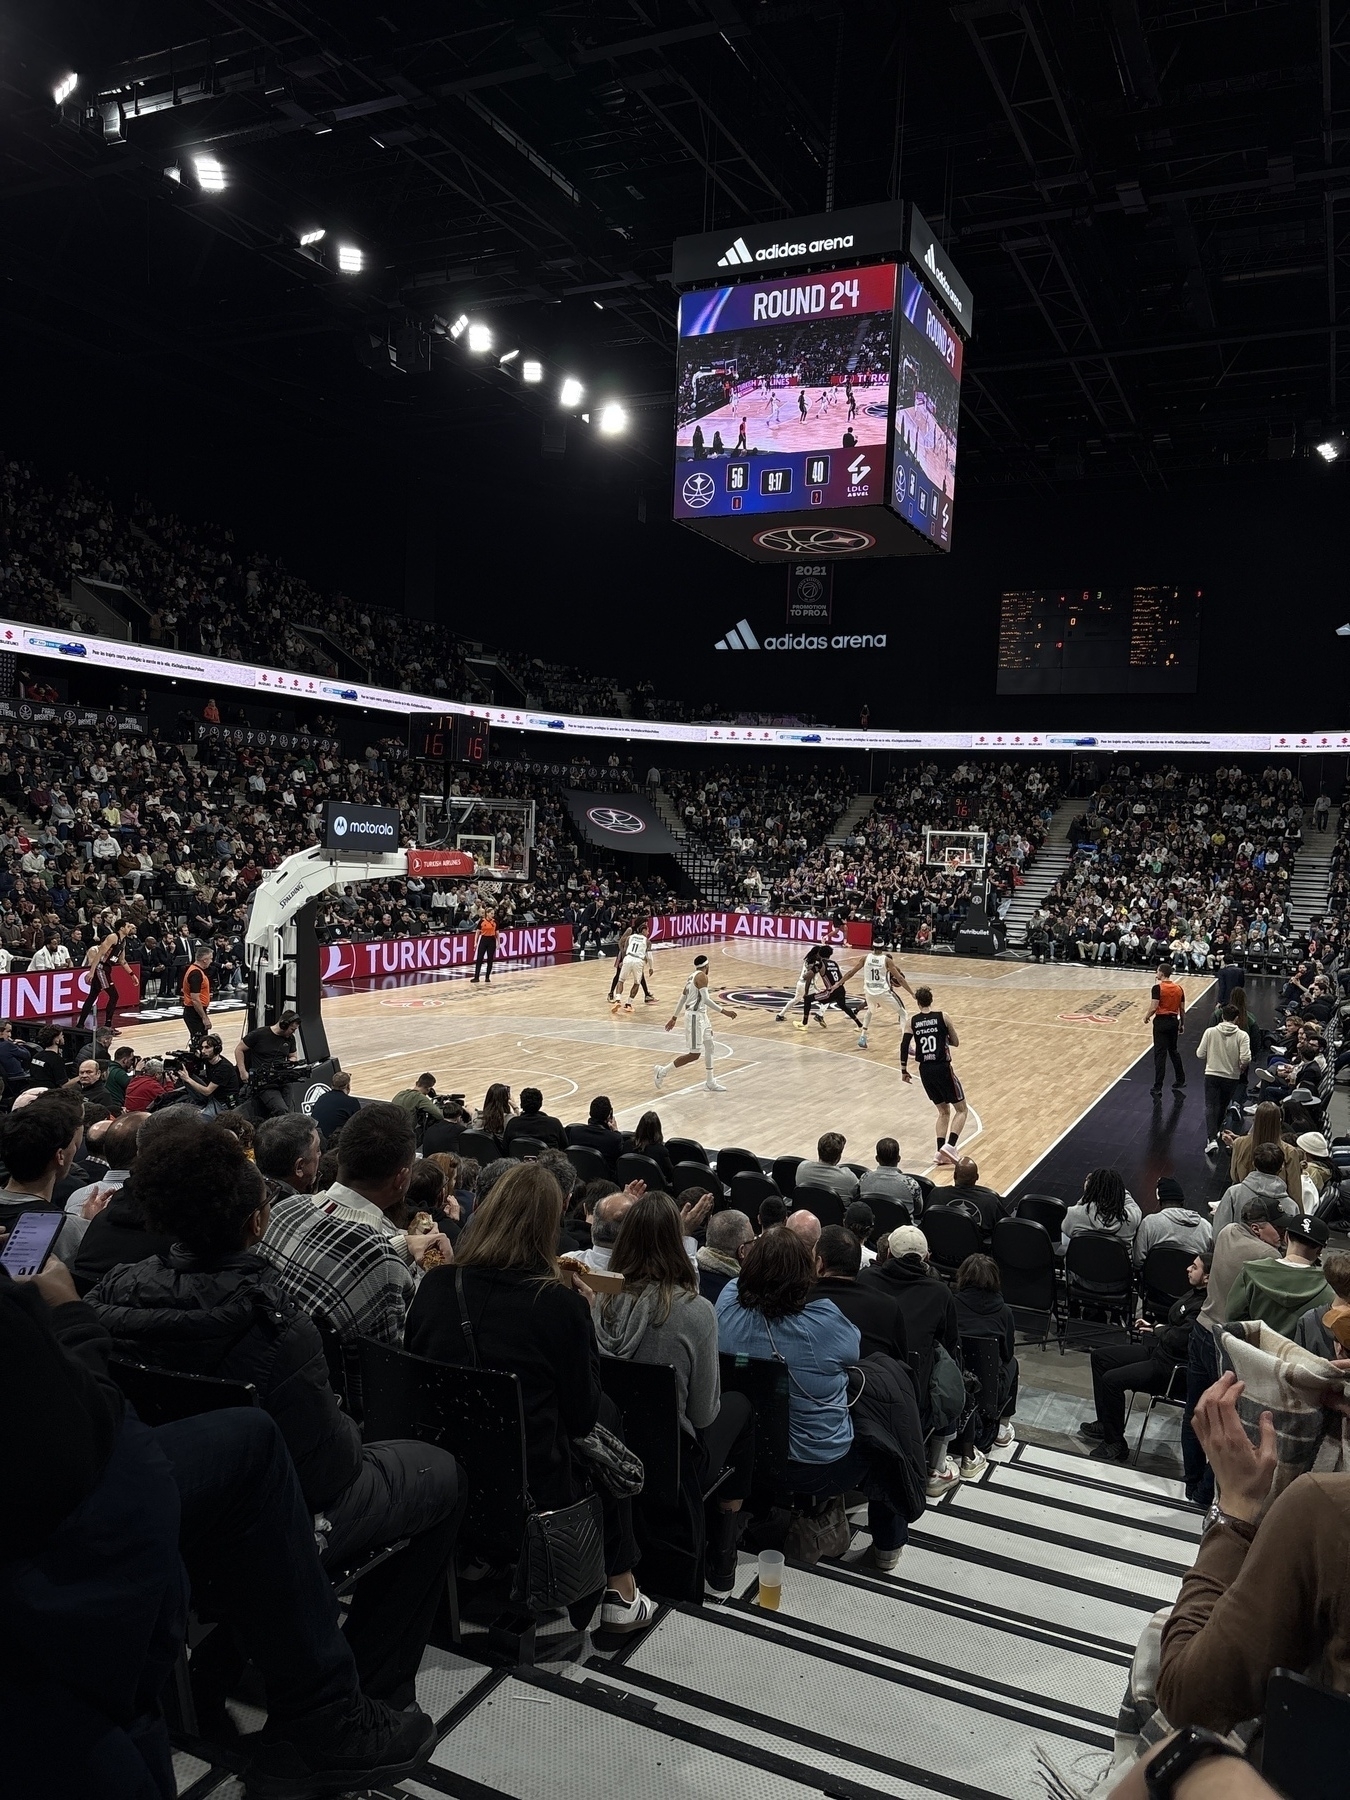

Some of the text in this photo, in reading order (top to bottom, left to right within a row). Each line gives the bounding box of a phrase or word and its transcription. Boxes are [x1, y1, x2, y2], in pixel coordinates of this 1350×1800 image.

[756, 234, 854, 261] adidas arena
[753, 279, 859, 321] ROUND 24
[926, 308, 956, 368] ROUND 24
[732, 467, 743, 489] 56
[812, 460, 823, 483] 40
[768, 472, 783, 492] 9:17
[795, 566, 826, 576] 2021
[764, 633, 887, 650] adidas arena
[119, 723, 143, 732] BASKETBALL
[425, 734, 443, 755] 16
[468, 737, 482, 759] 16
[957, 807, 968, 816] 16
[350, 821, 394, 836] motorola
[423, 858, 461, 868] TURKISH AIRLINES
[280, 882, 304, 909] SPALDING
[670, 913, 844, 943] TURKISH AIRLINES
[366, 935, 467, 973] TURKISH
[474, 927, 556, 960] RLINES
[632, 943, 639, 953] 11
[871, 969, 880, 981] 13
[920, 1035, 937, 1054] 20
